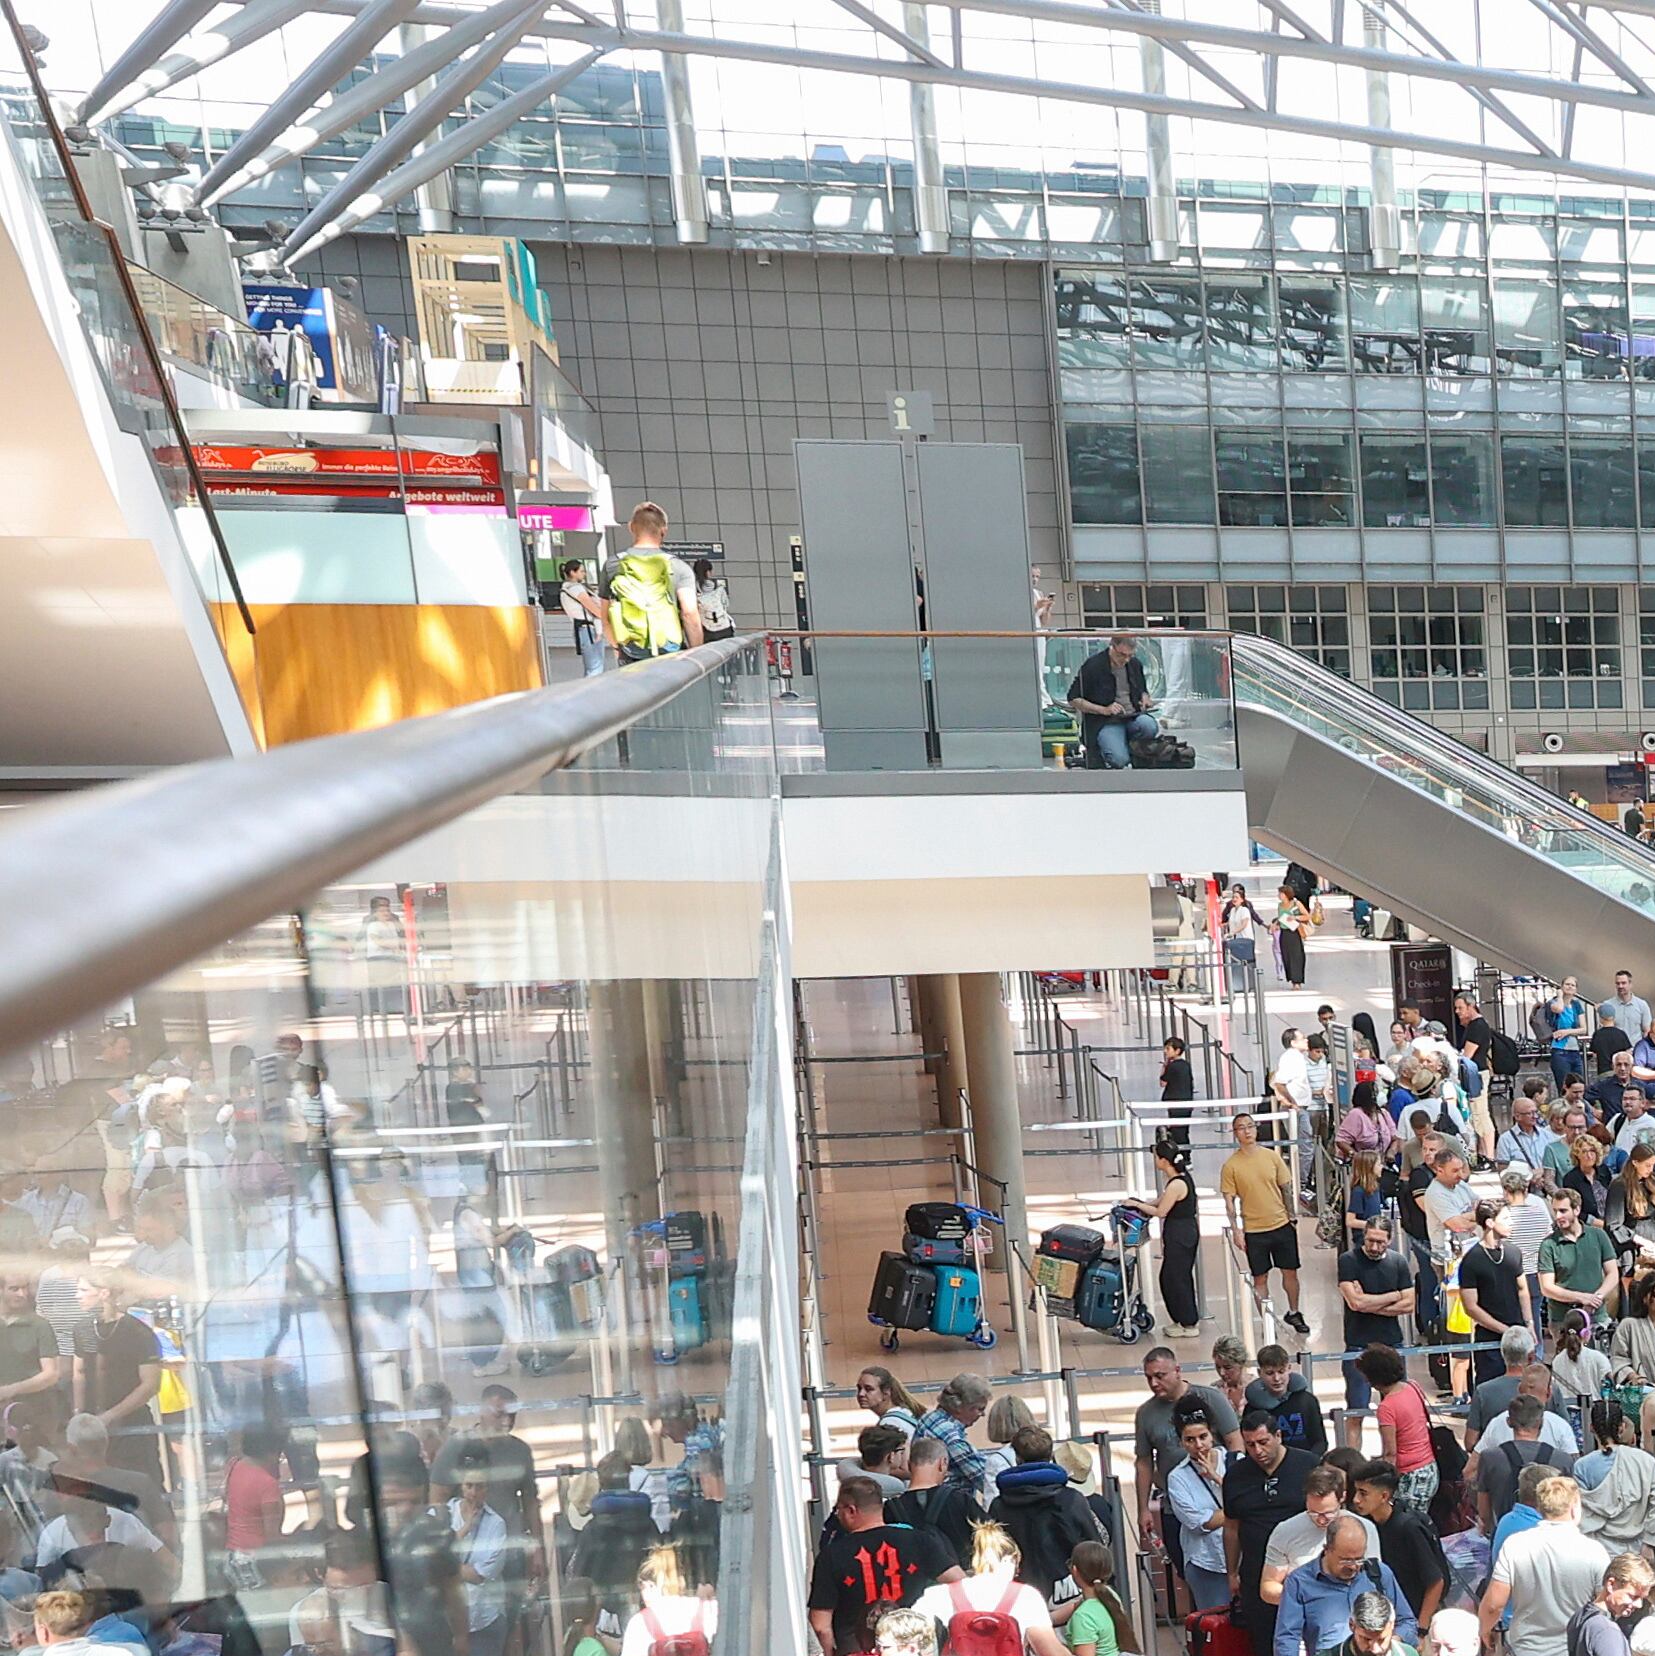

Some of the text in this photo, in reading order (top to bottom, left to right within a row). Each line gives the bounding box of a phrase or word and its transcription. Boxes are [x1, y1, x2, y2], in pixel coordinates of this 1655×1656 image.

[206, 487, 495, 503] Last-Minute Angebote weltweit
[521, 515, 553, 529] UTE
[1409, 960, 1439, 970] QATAR
[854, 1541, 904, 1604] 13
